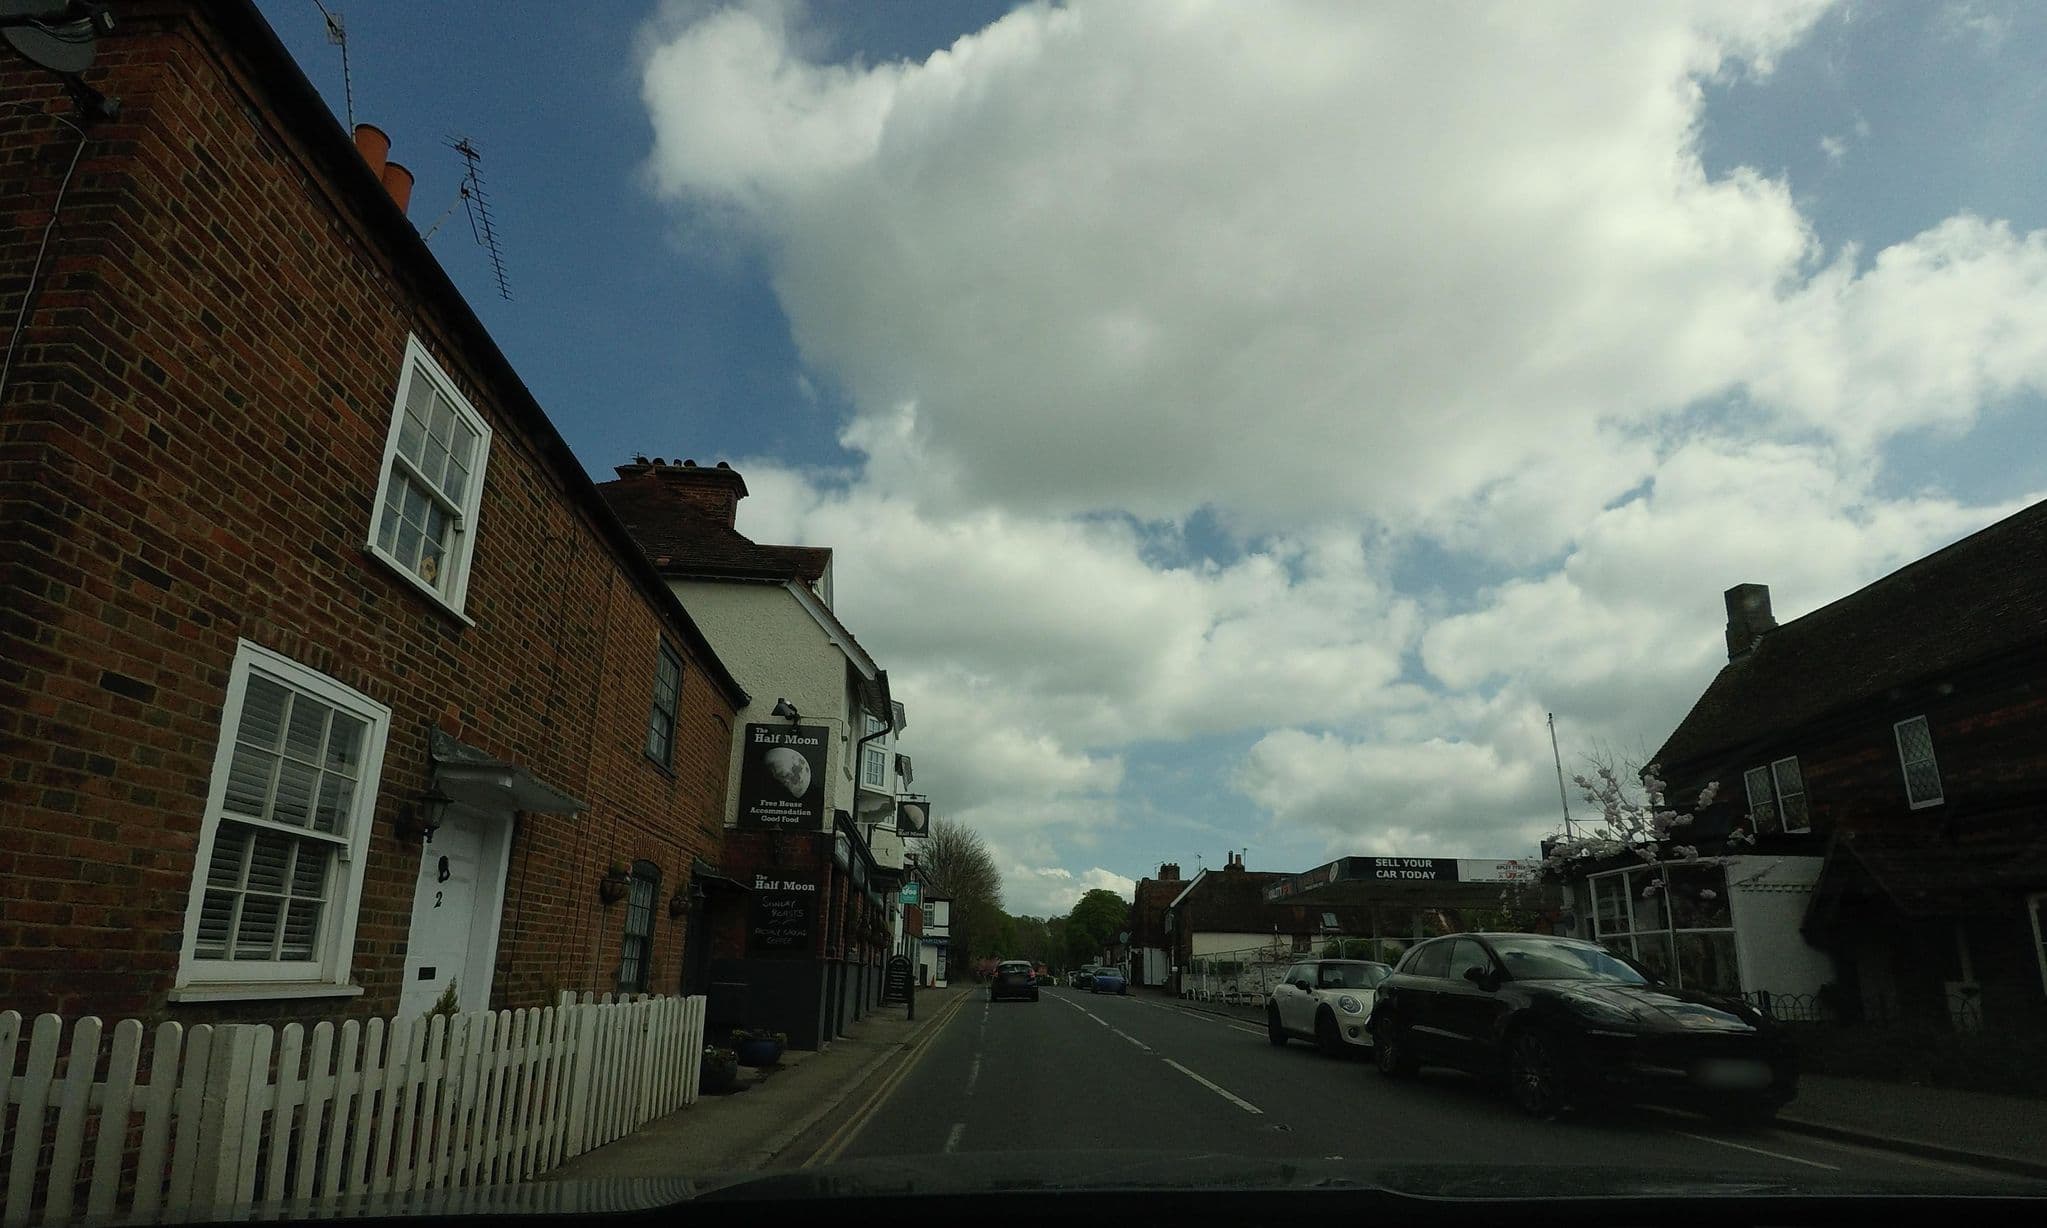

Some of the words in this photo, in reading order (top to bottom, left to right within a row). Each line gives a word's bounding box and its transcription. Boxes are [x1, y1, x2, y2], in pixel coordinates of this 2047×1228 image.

[755, 733, 781, 743] Half
[783, 734, 819, 745] Moon
[760, 799, 778, 807] Free
[779, 800, 803, 808] House
[750, 806, 812, 816] Accommodation
[1375, 858, 1401, 867] SELL
[1402, 859, 1433, 868] YOUR
[1376, 870, 1398, 879] CAR
[1400, 870, 1436, 880] TODAY
[754, 880, 779, 890] Half
[783, 881, 815, 891] Moon
[434, 891, 443, 908] 2
